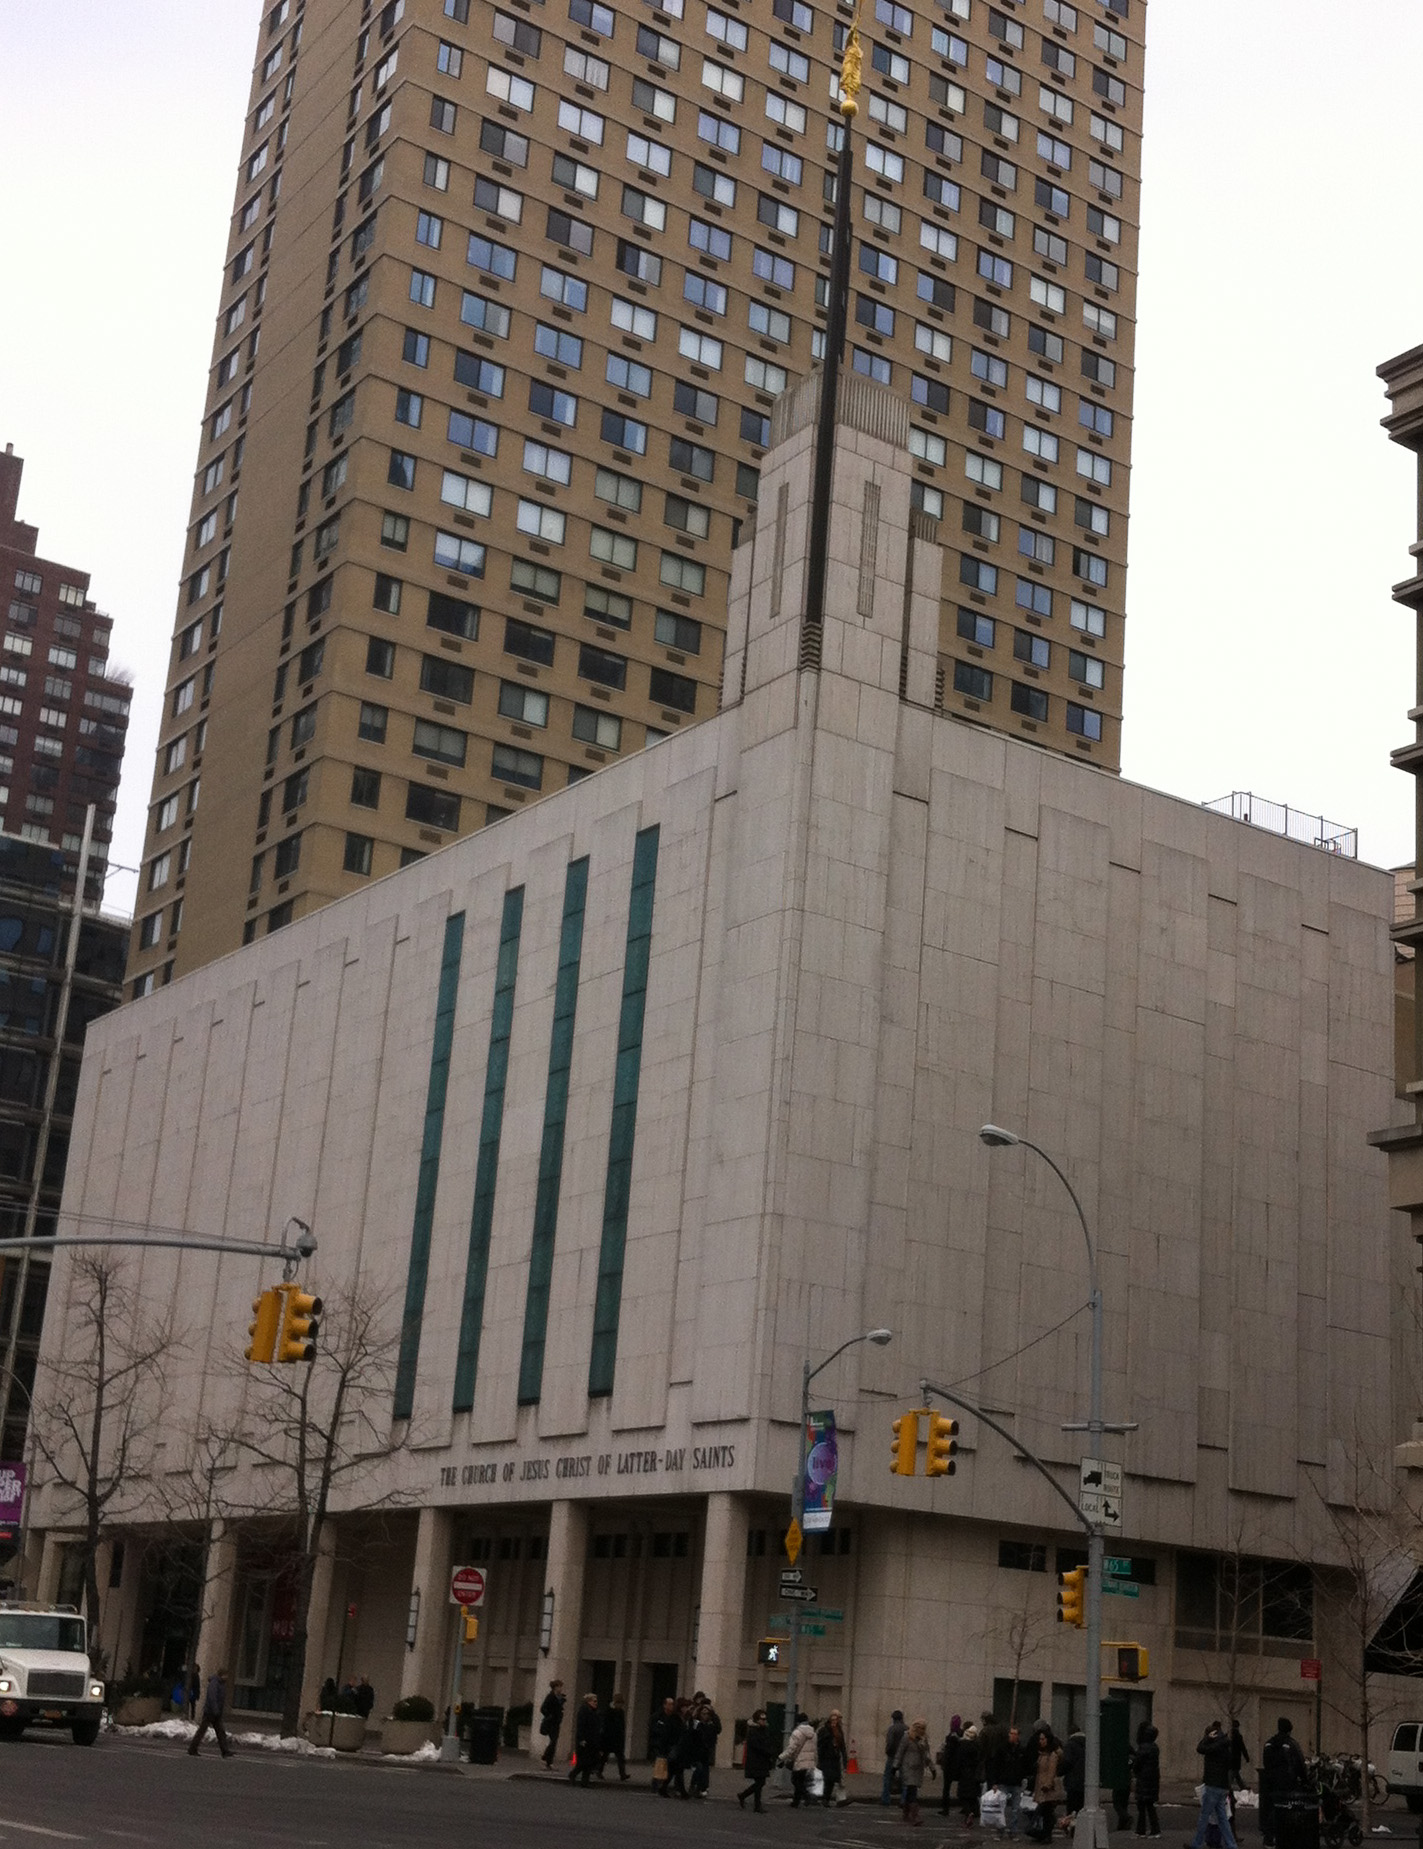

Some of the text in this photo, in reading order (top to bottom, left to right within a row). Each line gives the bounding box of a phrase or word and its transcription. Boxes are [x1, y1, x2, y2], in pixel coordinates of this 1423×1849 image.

[440, 1445, 735, 1486] THE CHURCH OF JESUS CHRIST OF LATTER-DAY SAINTS
[1081, 1503, 1099, 1513] LOCAL
